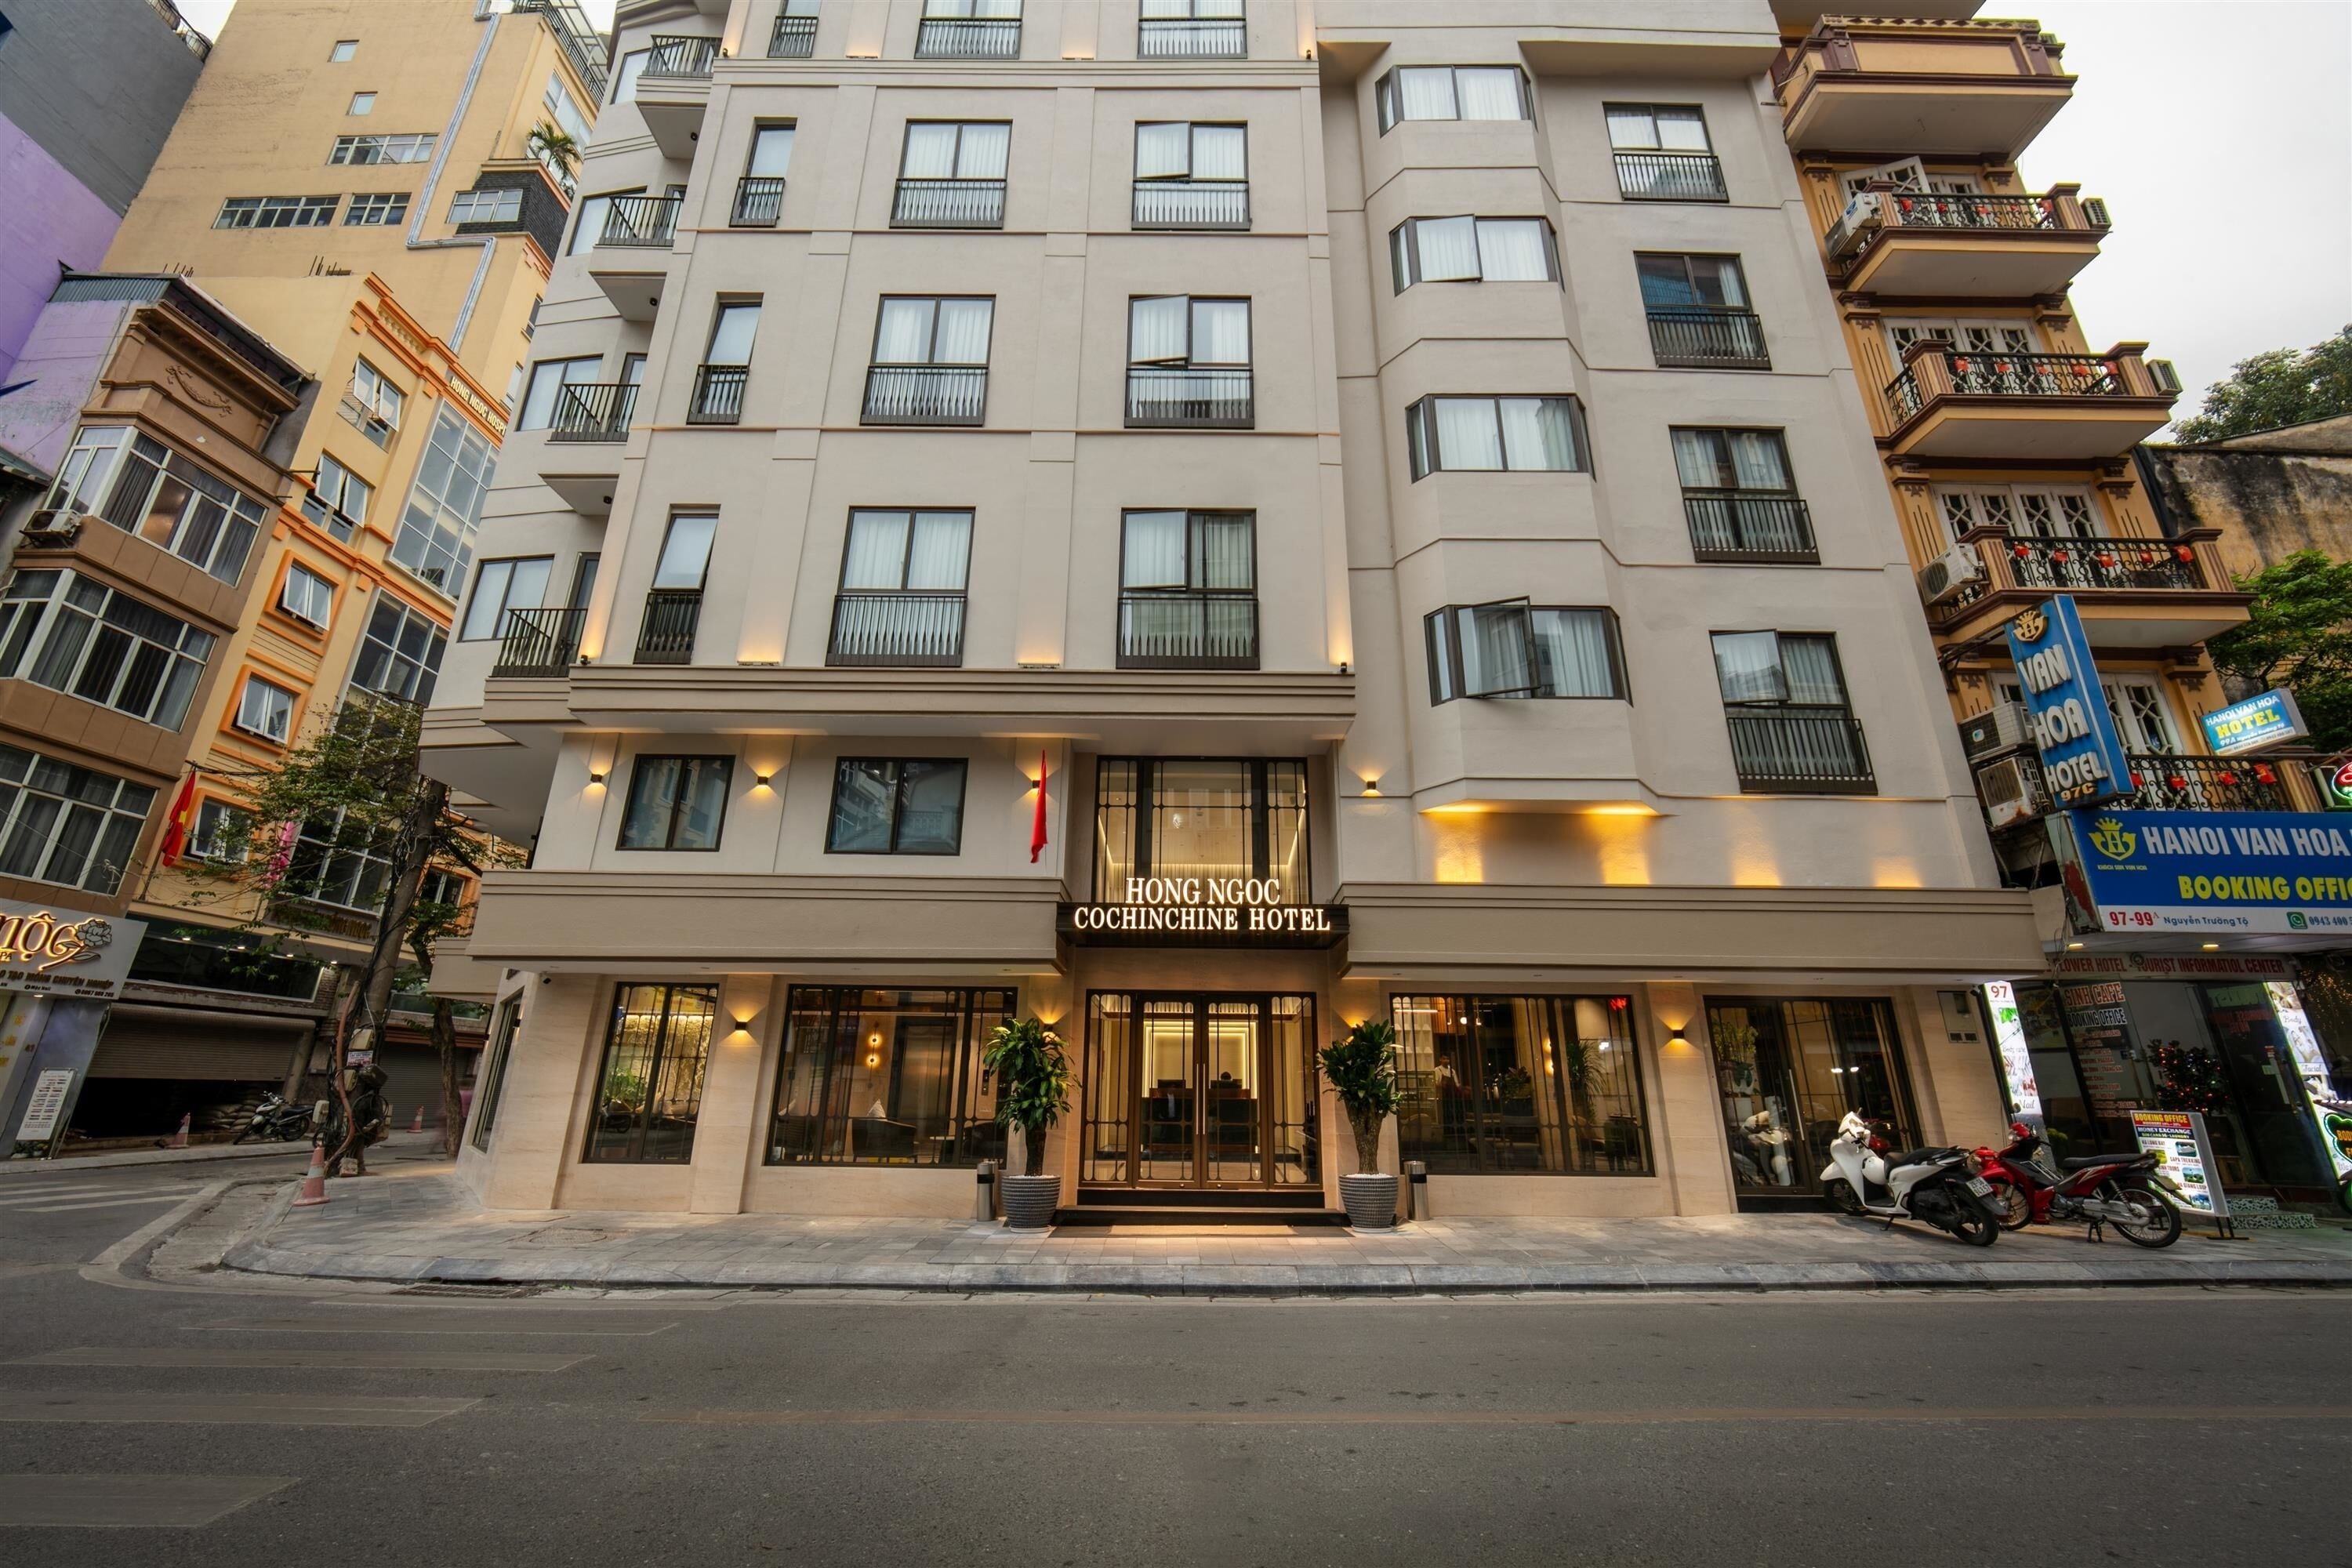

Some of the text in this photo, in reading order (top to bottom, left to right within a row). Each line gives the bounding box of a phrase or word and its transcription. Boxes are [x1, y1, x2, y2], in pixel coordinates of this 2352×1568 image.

[450, 376, 470, 401] HONG
[469, 394, 488, 418] NGOC
[2018, 644, 2108, 793] VAN HOA HOTEL
[2205, 695, 2280, 726] HANOI VAN HOA
[2215, 709, 2280, 739] HOTEL
[2060, 782, 2097, 801] 97C
[2141, 826, 2351, 857] HANOI VAN HOA
[1125, 877, 1280, 905] HONG NGOC
[2178, 875, 2290, 901] BOOKING
[1074, 906, 1330, 931] COCHINCHINE HOTEL
[2095, 957, 2127, 972] HOTEL
[2246, 959, 2285, 973] CENTER
[1991, 985, 2008, 998] 97
[2065, 982, 2125, 1006] SINH CAFE
[2067, 1008, 2128, 1027] BOOKING OFFICE
[2134, 1113, 2163, 1122] BOOKING
[2165, 1114, 2188, 1123] OFFICE
